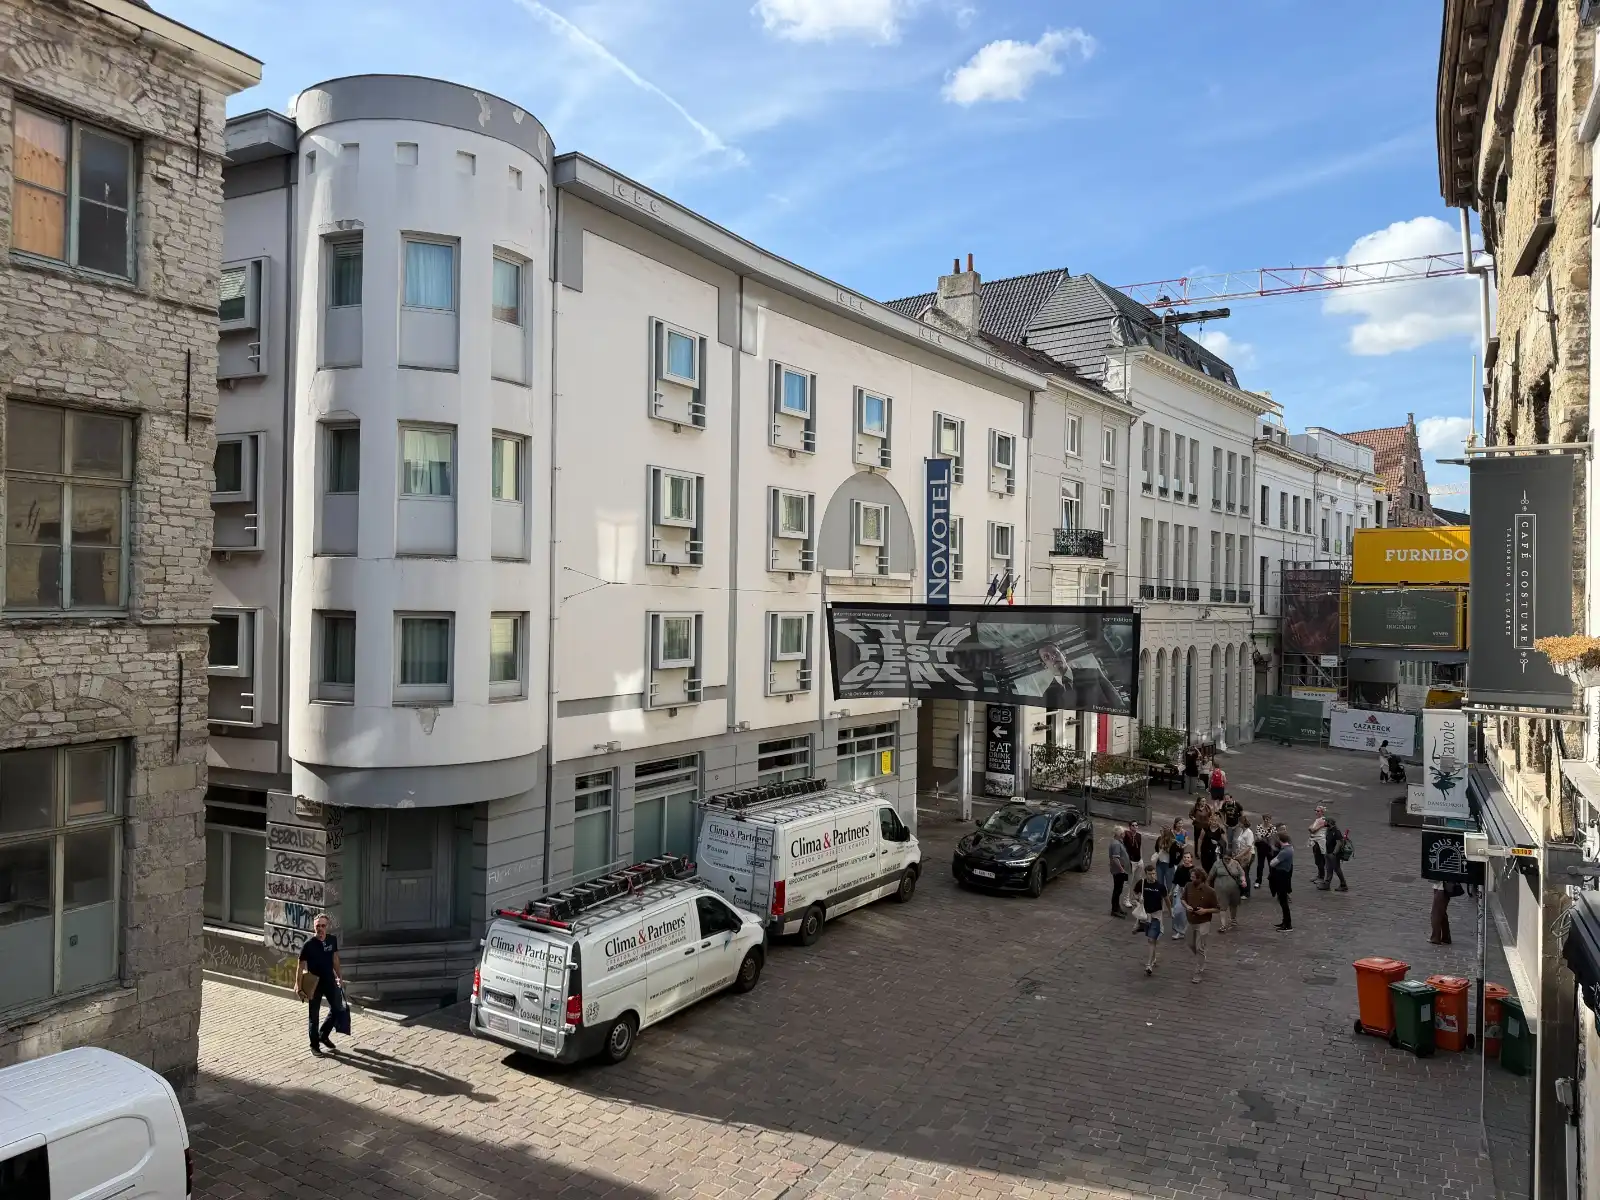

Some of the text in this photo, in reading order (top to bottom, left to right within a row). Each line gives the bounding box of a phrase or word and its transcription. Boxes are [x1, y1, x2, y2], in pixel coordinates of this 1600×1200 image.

[928, 468, 949, 599] NOVOTEL
[1384, 548, 1469, 562] FURNIBO
[1520, 521, 1531, 642] CAFÉ COSTUME
[834, 620, 972, 646] FILM
[857, 643, 954, 663] FEST
[841, 661, 976, 684] GENT
[1353, 722, 1391, 733] CAZAERCK
[989, 741, 1012, 753] EAT
[989, 752, 1011, 760] DRINK
[709, 824, 729, 838] Clima
[791, 837, 822, 858] Clima
[823, 832, 832, 849] &
[832, 824, 870, 846] Partners
[1429, 838, 1452, 854] SOUS
[604, 916, 686, 958] Clima & Partners
[490, 936, 564, 965] Clima & Partners
